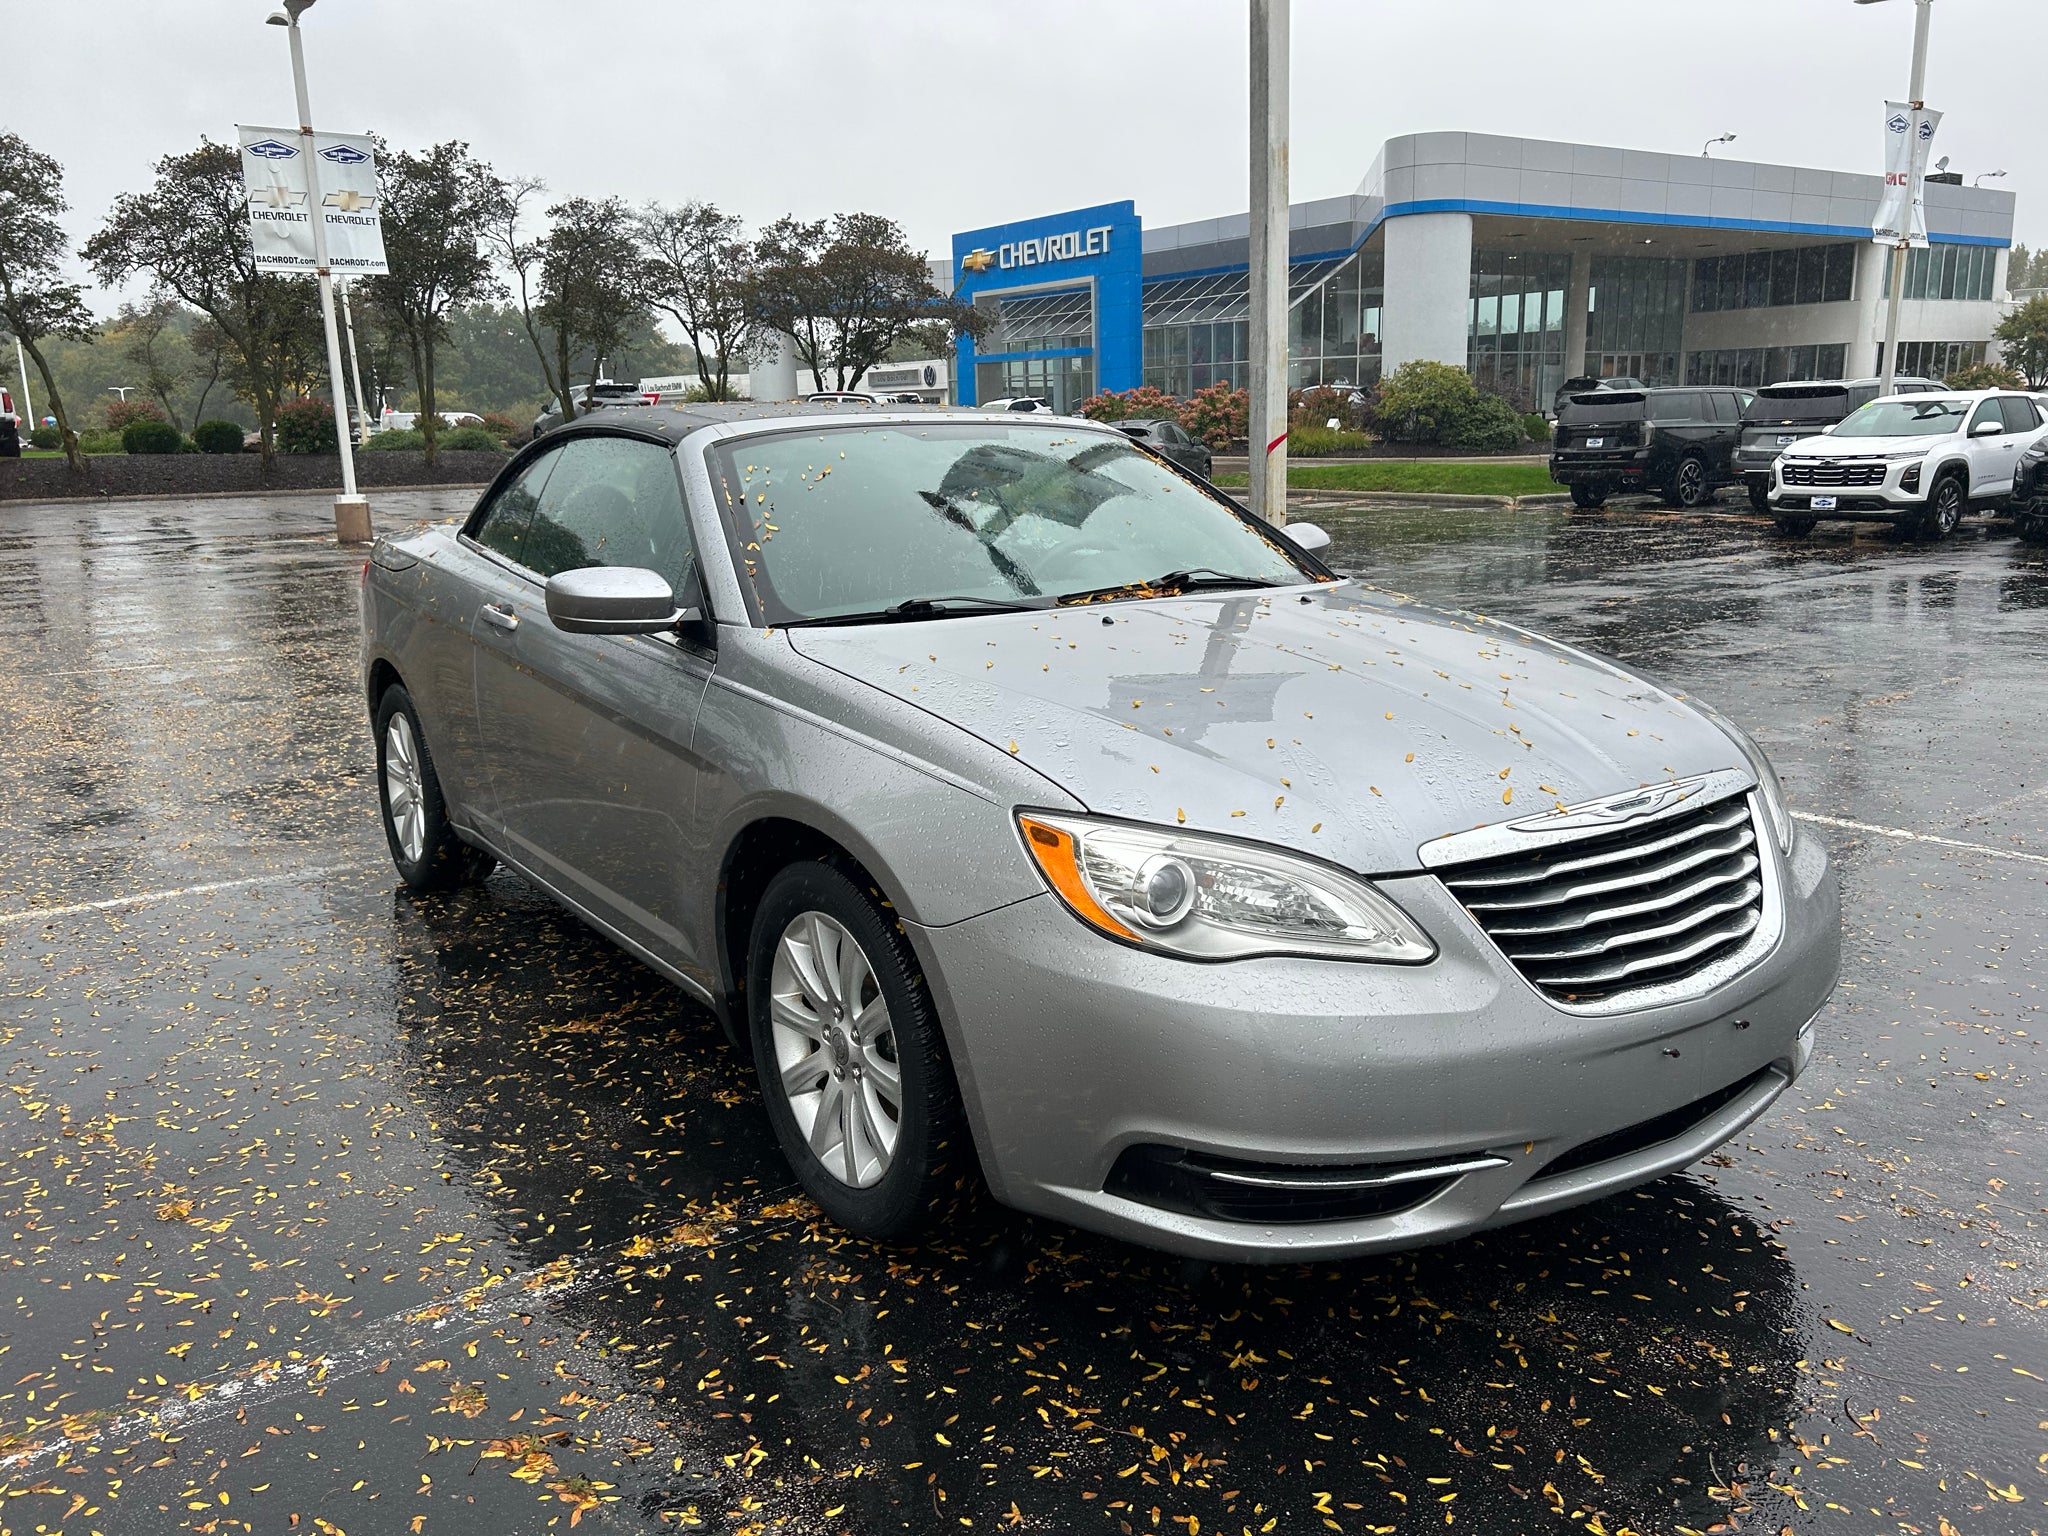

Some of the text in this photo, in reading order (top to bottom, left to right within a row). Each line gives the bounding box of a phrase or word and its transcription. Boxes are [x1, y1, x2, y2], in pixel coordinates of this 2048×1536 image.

[253, 211, 308, 222] CHEVROLET
[325, 214, 377, 226] CHEVROLET
[999, 225, 1112, 269] CHEVROLET
[256, 255, 316, 265] BACHRODT.com
[329, 258, 386, 267] BACHRODT.com
